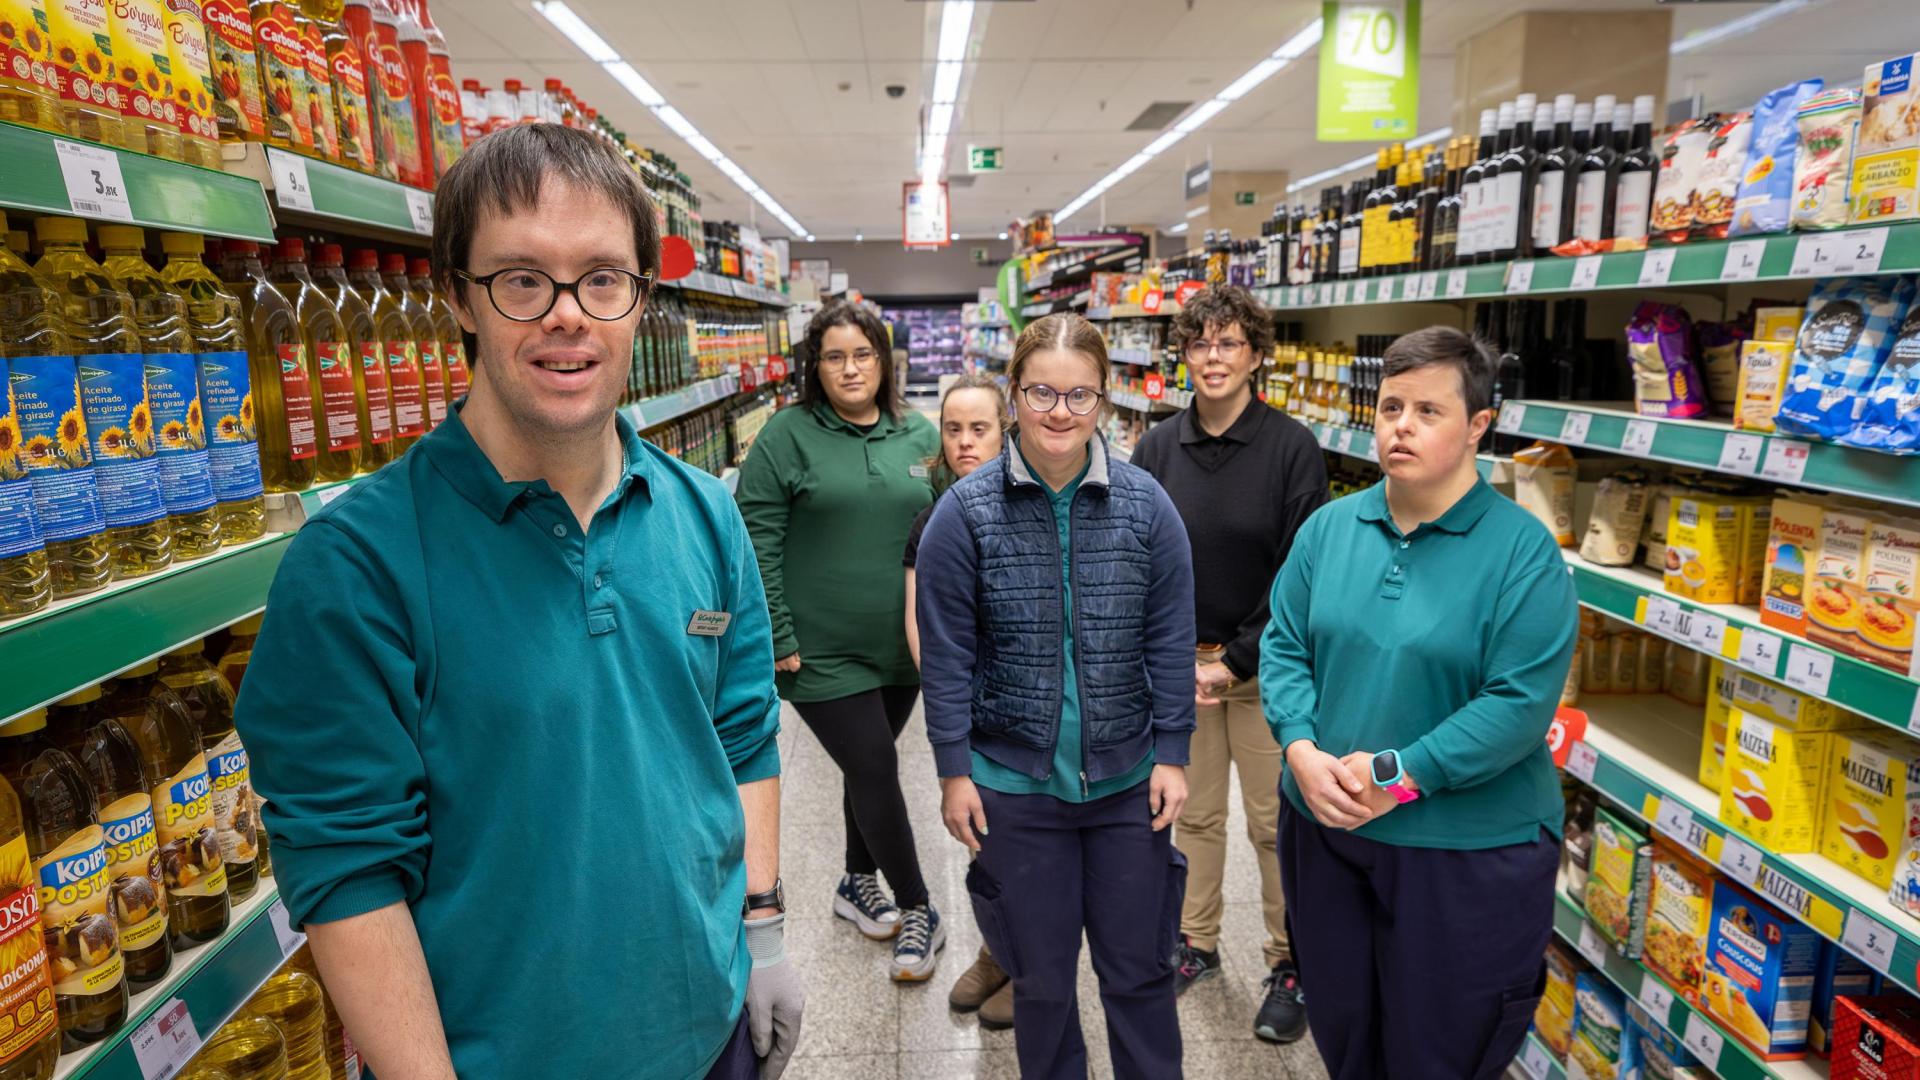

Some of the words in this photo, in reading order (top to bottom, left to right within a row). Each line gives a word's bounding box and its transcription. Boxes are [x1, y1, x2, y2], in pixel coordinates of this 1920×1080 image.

[1735, 727, 1777, 763] MAIZENA
[1840, 756, 1895, 797] MAIZENA
[1756, 864, 1815, 918] MAIZENA
